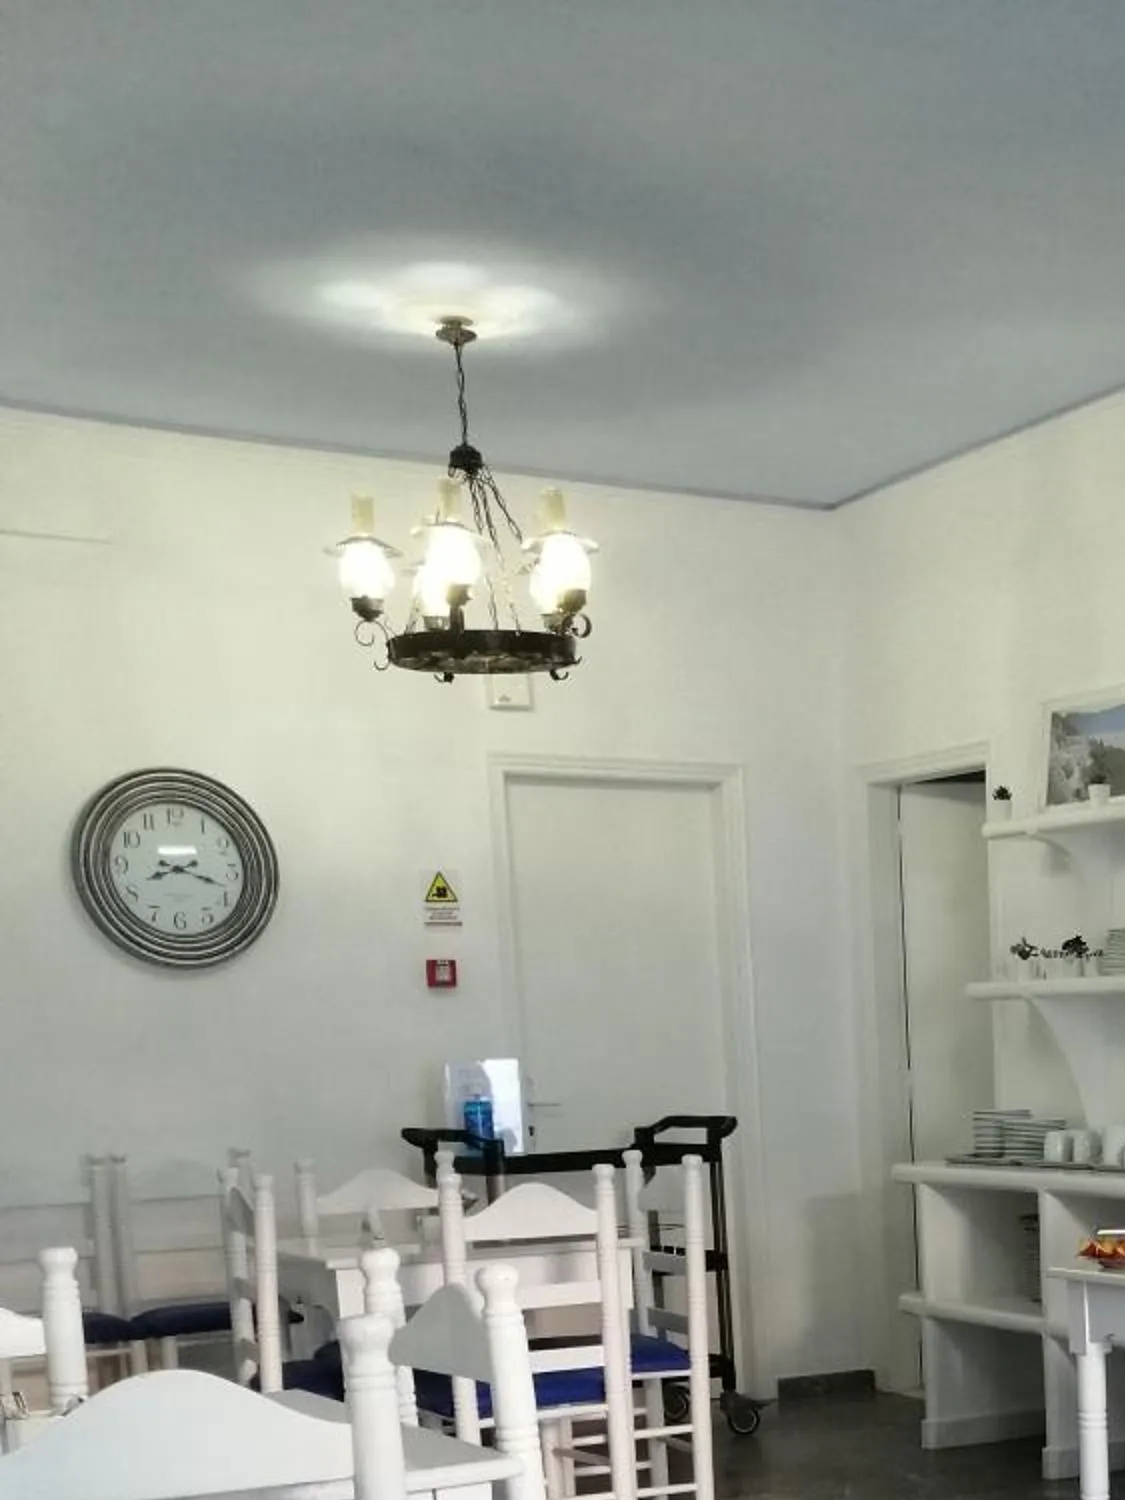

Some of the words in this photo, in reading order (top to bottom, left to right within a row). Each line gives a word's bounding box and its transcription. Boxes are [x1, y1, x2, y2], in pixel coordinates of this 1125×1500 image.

[143, 812, 155, 831] 11
[166, 807, 185, 826] 12
[123, 831, 141, 848] 10
[217, 838, 229, 855] 2
[115, 855, 129, 874] 9
[225, 862, 239, 881] 3
[147, 904, 161, 922] 7
[173, 911, 187, 930] 6
